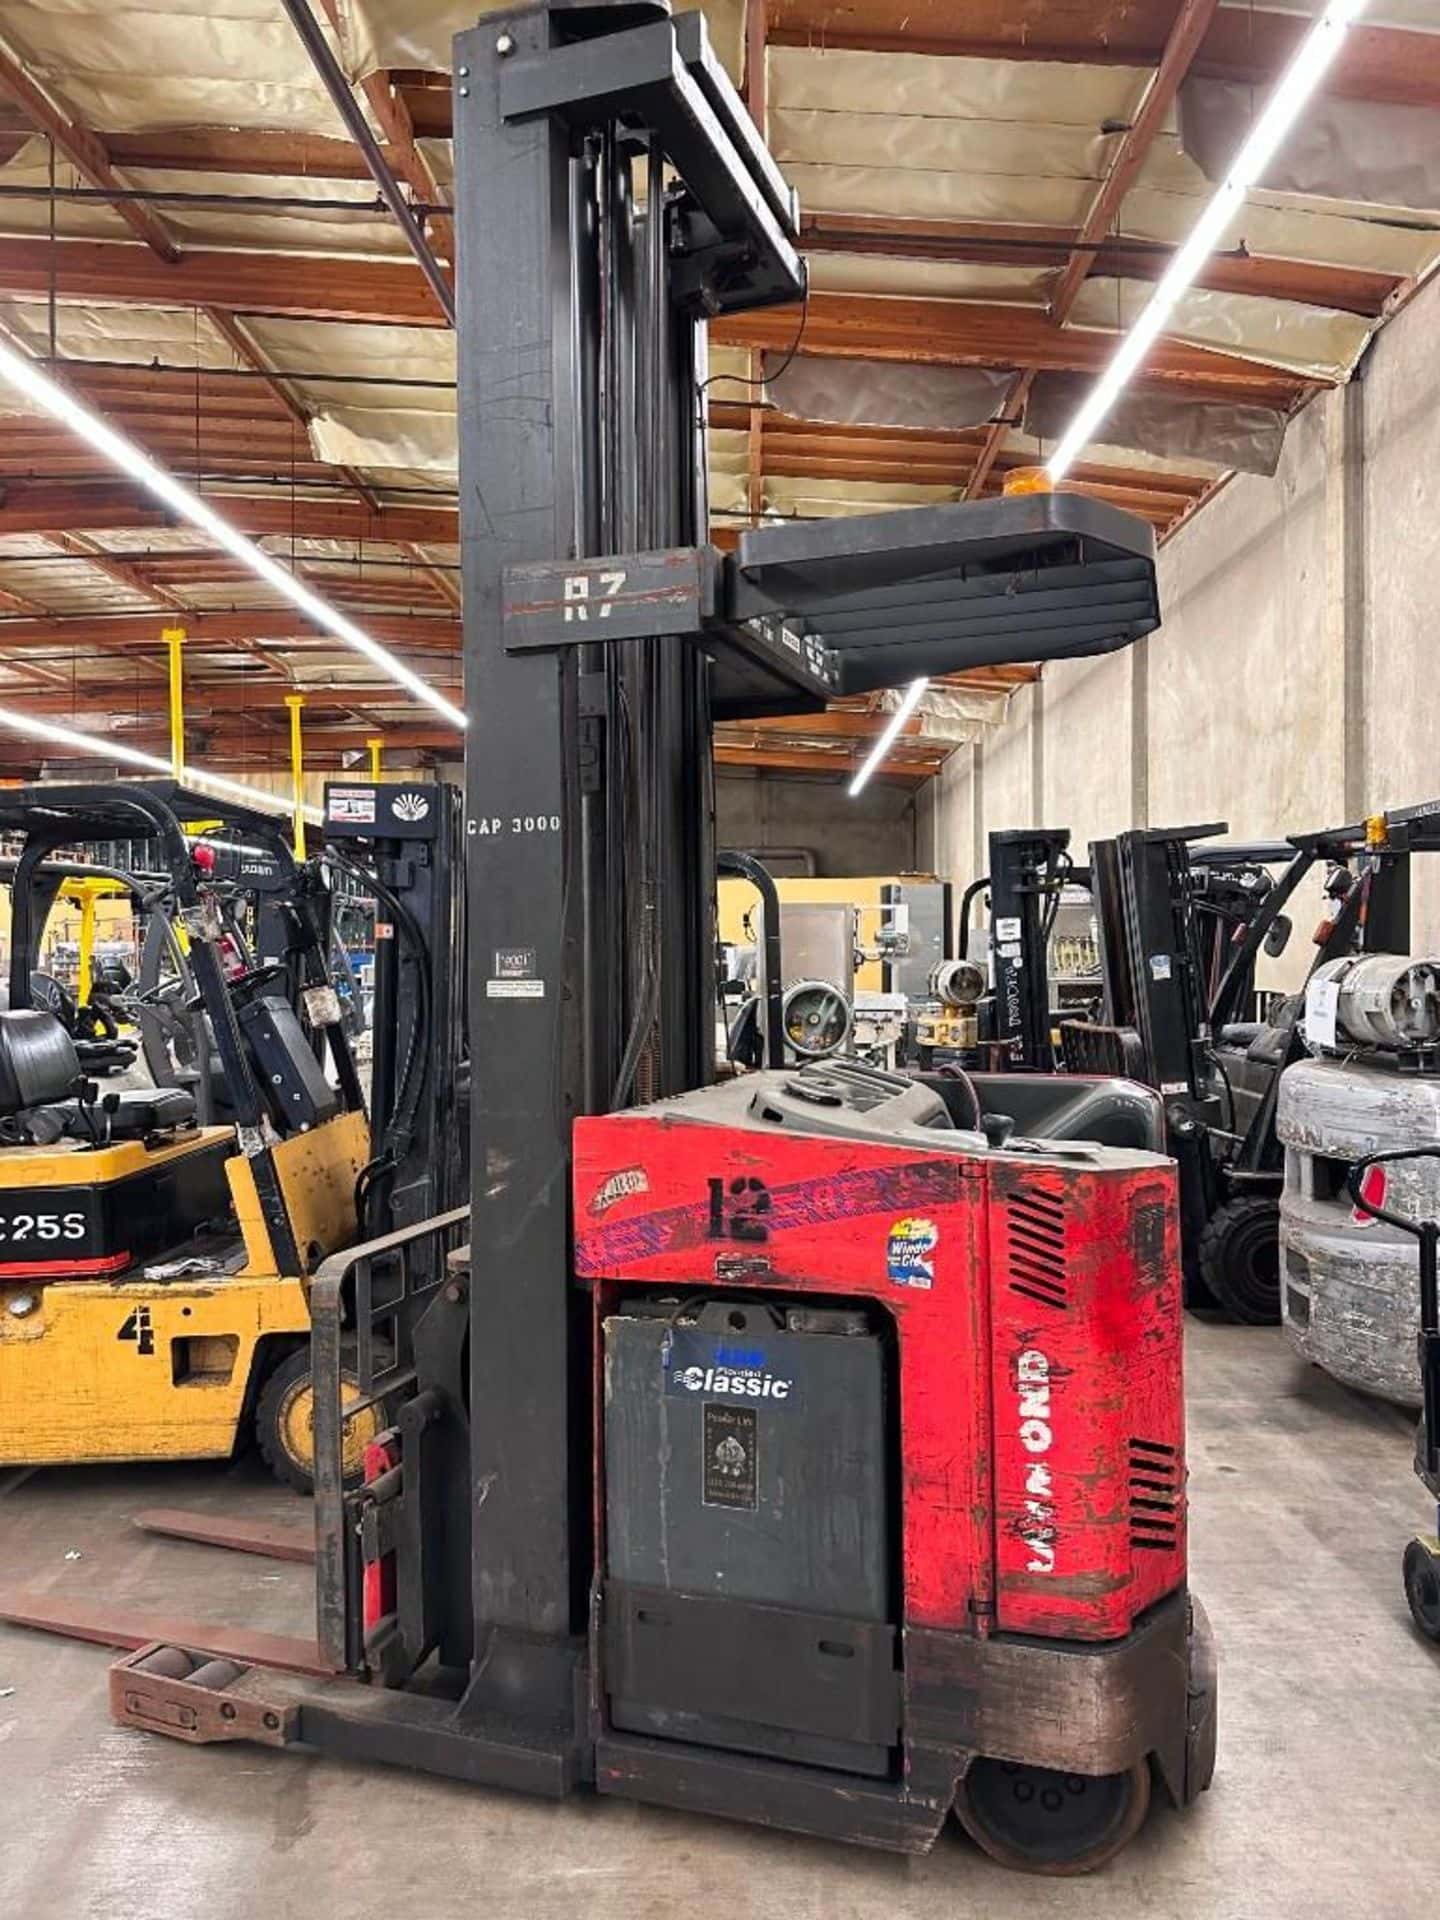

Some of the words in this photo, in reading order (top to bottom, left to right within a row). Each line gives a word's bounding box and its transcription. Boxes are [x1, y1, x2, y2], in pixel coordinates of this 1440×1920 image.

[564, 572, 626, 621] R7
[467, 818, 502, 835] CAP
[511, 815, 560, 833] 3000
[117, 1305, 154, 1354] 4
[684, 1367, 790, 1398] Classic
[1017, 1350, 1054, 1572] MOND
